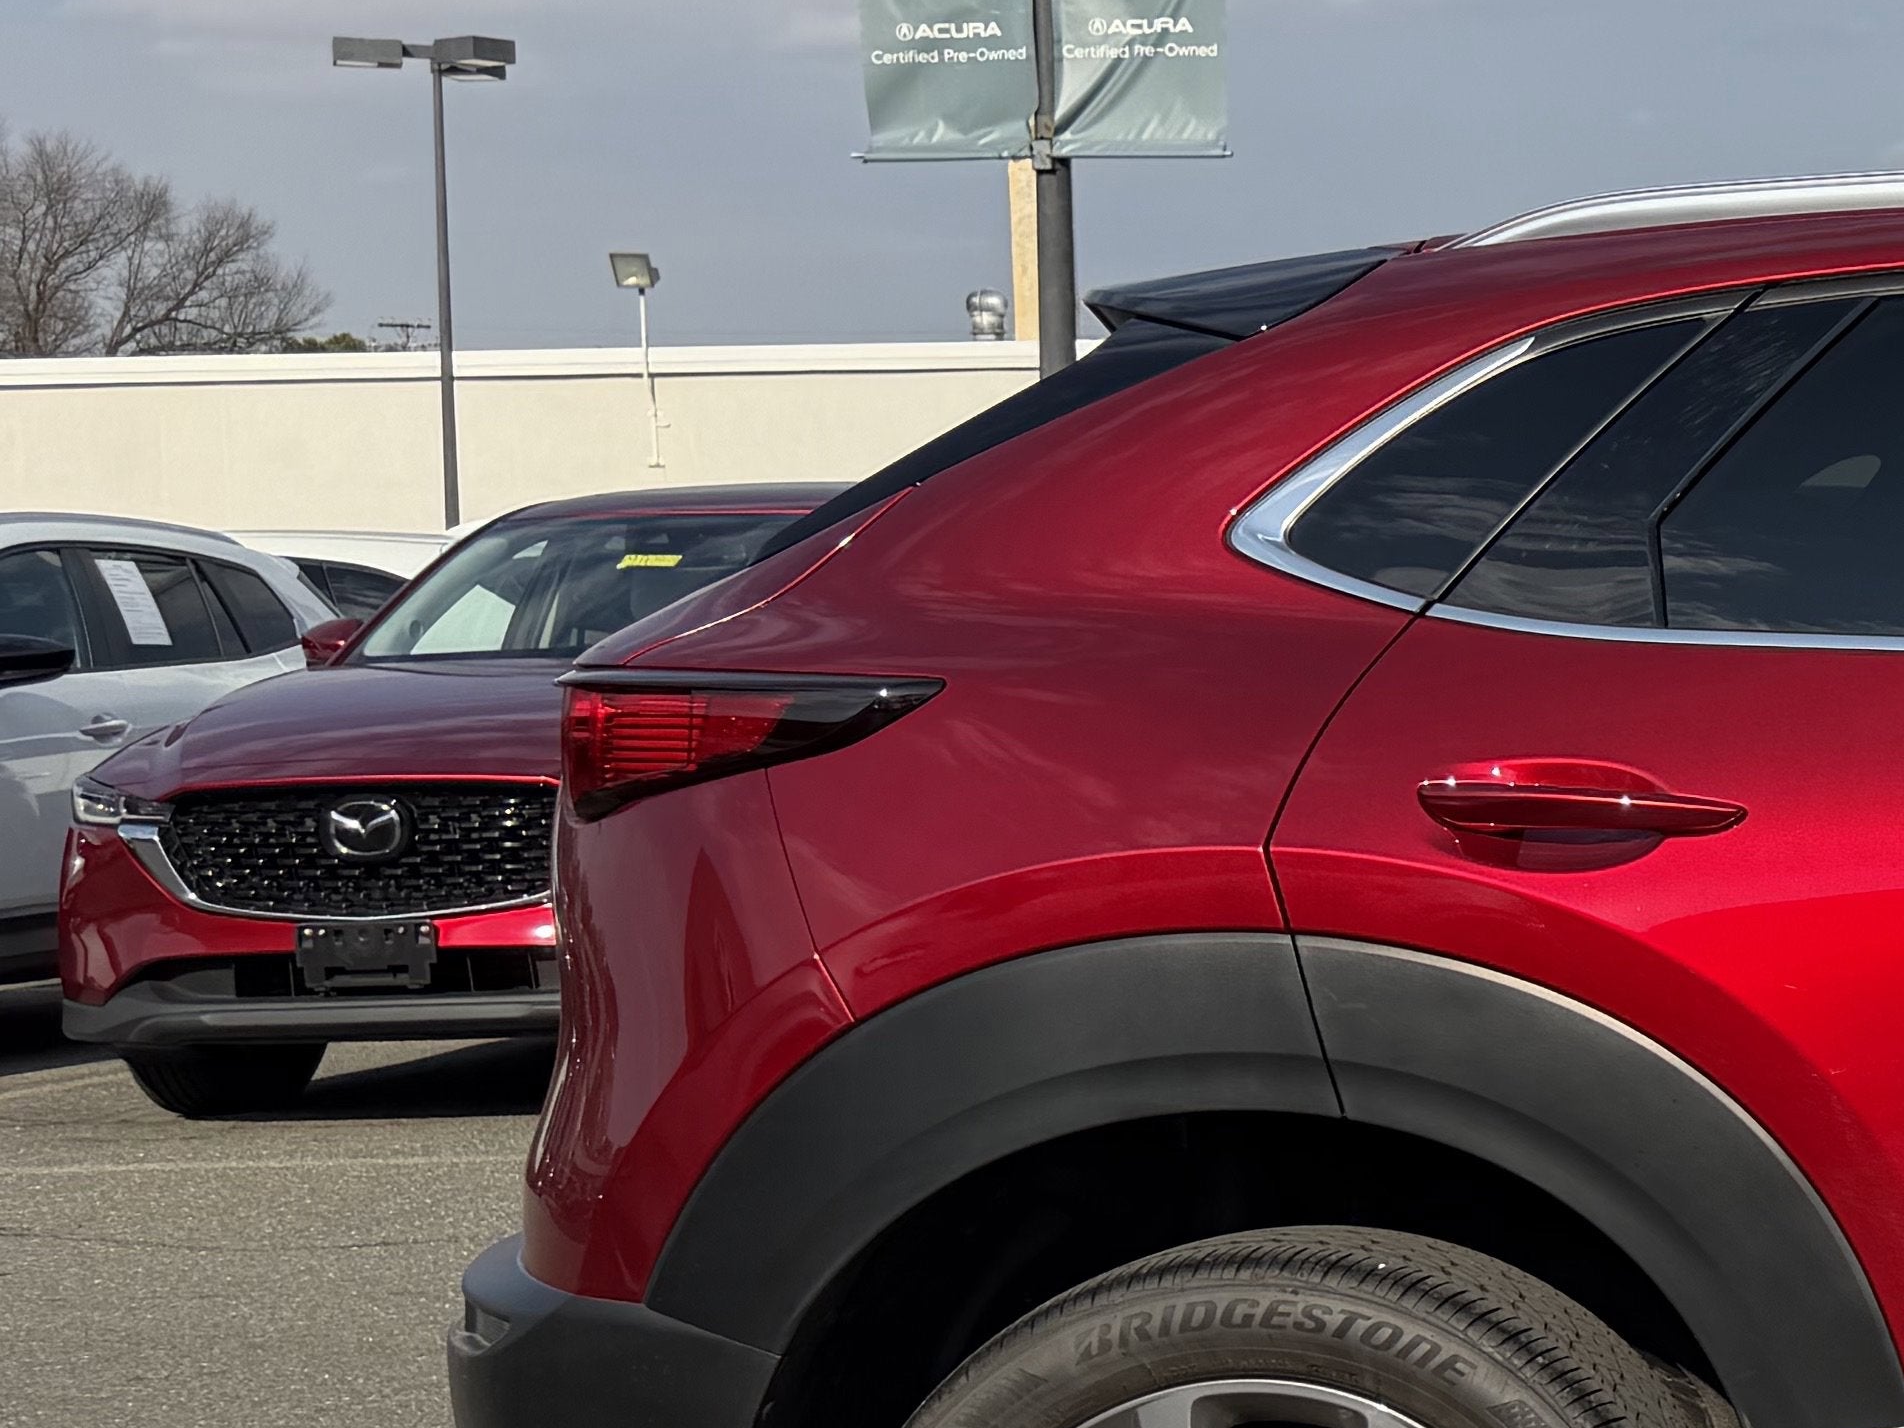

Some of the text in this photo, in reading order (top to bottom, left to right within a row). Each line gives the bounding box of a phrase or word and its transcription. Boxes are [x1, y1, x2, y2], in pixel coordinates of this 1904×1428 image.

[914, 21, 1002, 40] ACURA
[1107, 17, 1194, 35] ACURA
[871, 46, 1027, 65] Certified Pre-Owned
[1062, 43, 1130, 59] Certified
[1074, 1298, 1479, 1386] BRIDGESTONE
